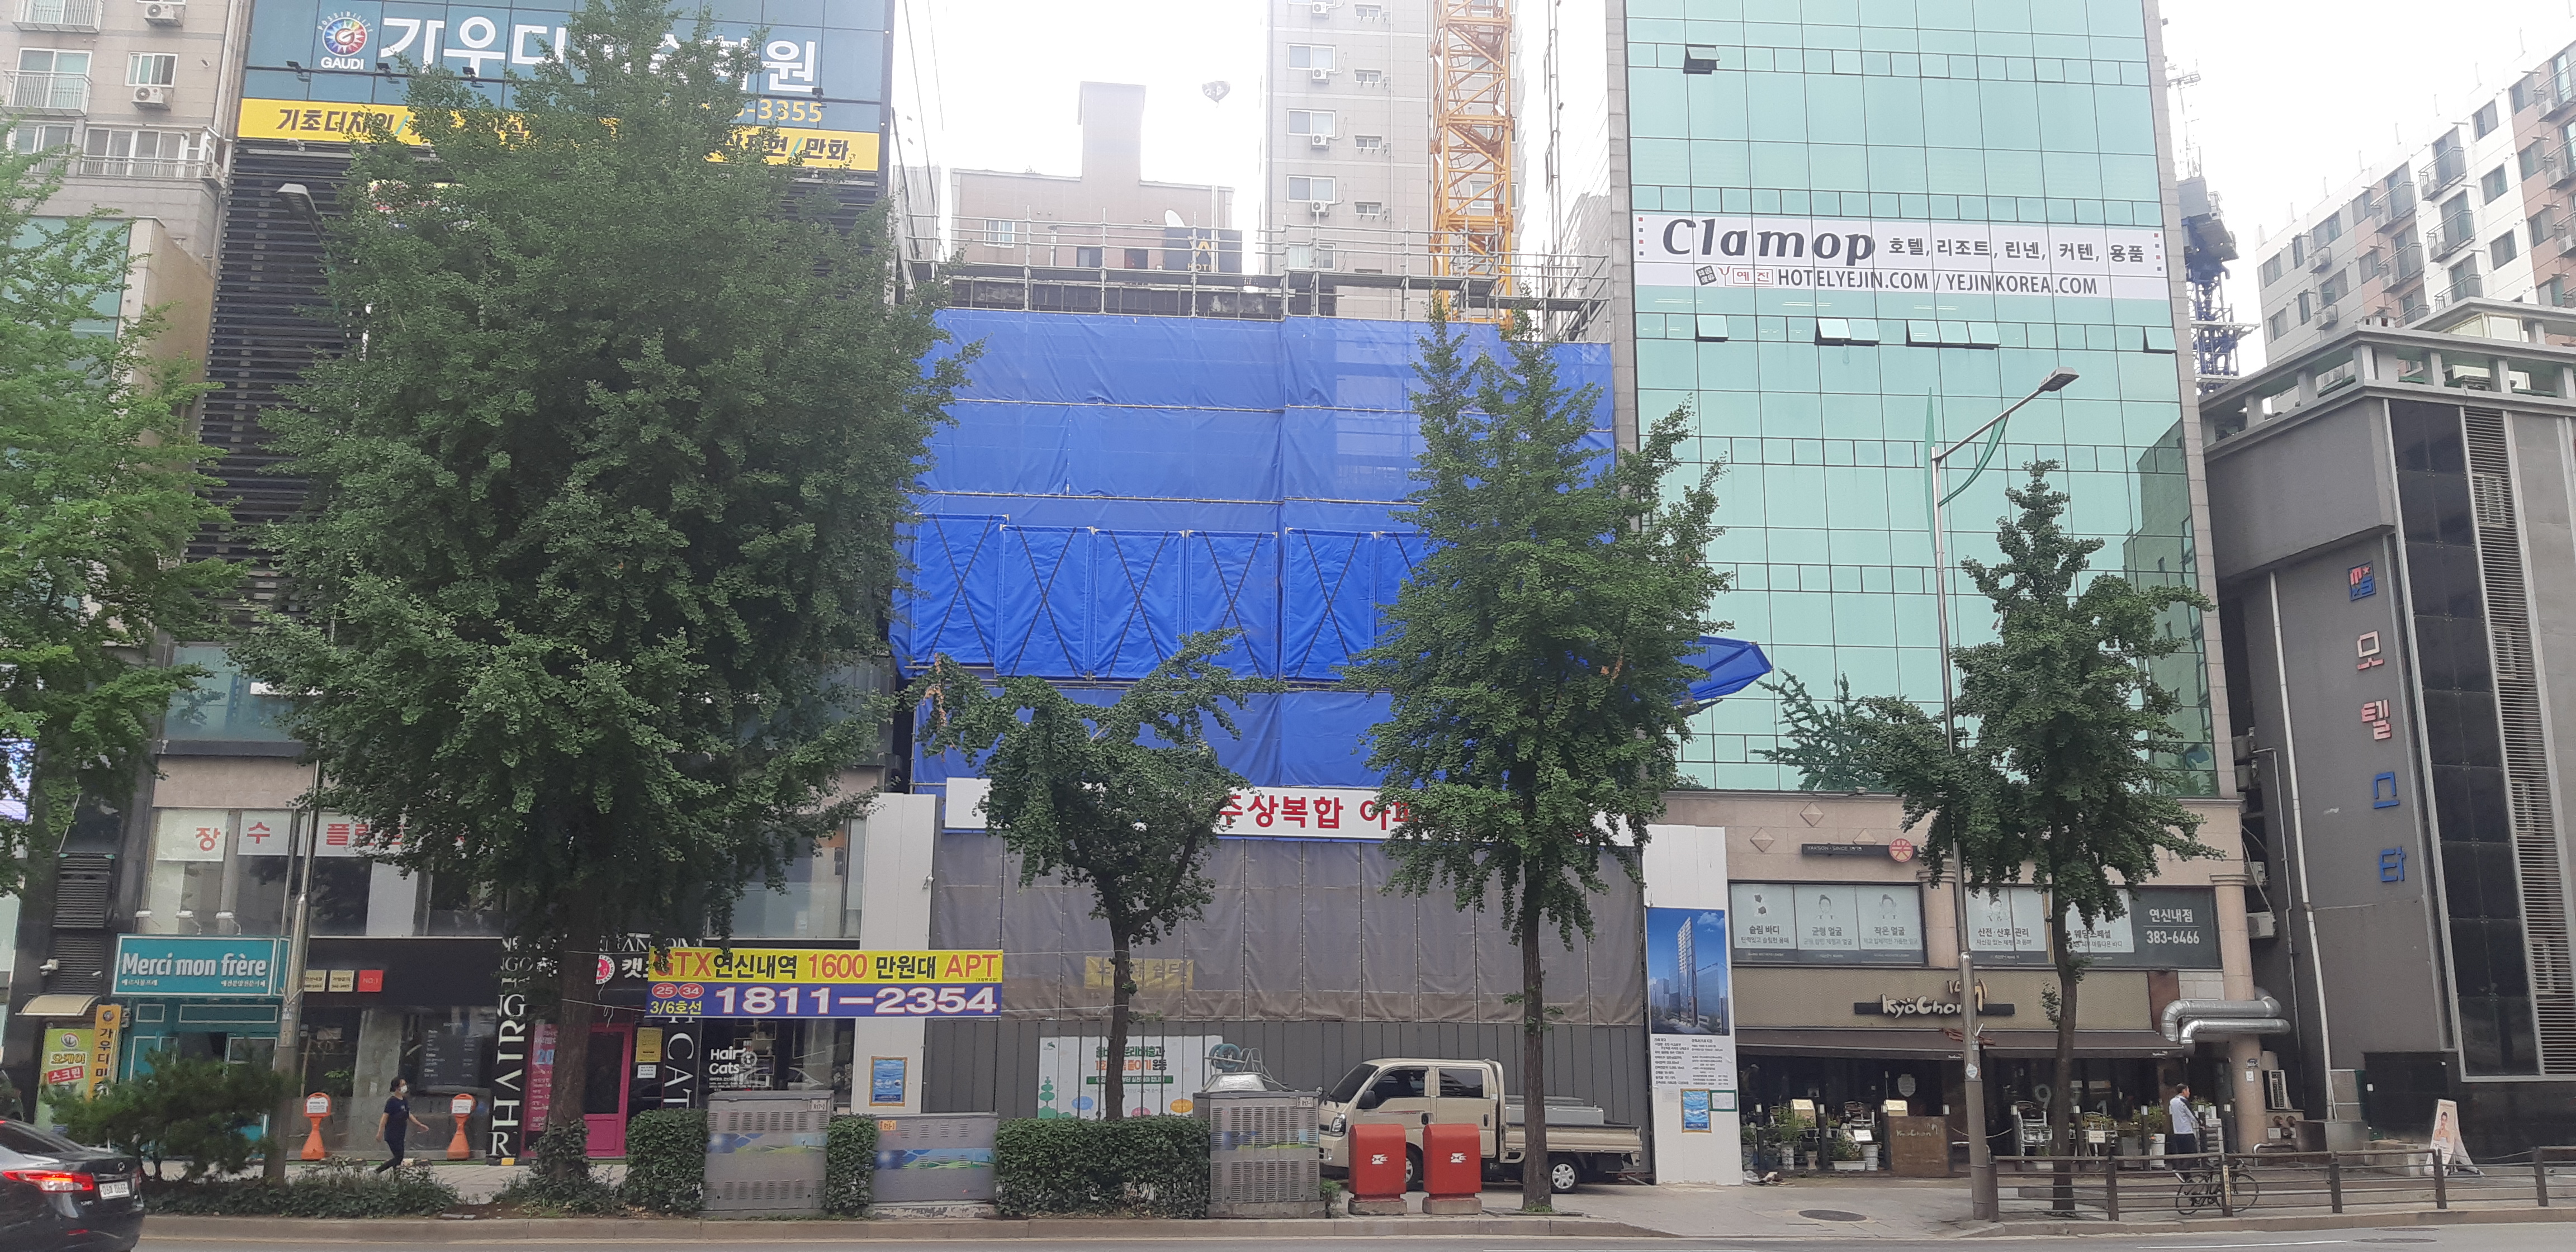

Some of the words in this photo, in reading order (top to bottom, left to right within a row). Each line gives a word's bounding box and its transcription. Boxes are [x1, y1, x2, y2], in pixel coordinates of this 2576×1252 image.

[321, 56, 364, 69] GAUDI
[805, 137, 849, 161] 만화
[1663, 218, 1876, 267] Clamop
[1888, 238, 1930, 257] 호텔,
[1936, 239, 1998, 259] 리조트,
[2005, 241, 2046, 261] 린넨,
[2059, 243, 2100, 263] 커텐,
[2109, 244, 2144, 263] 용품
[1736, 271, 1770, 282] 예진
[1778, 269, 1929, 290] HOTELYEJIN.COM
[1947, 273, 2098, 295] YEJINKOREA.COM
[1219, 796, 1344, 829] 주상복합
[2149, 908, 2194, 923] 연신내점
[1749, 925, 1764, 935] 슬림
[1765, 925, 1780, 935] 바디
[1874, 926, 1890, 936] 작은
[1890, 926, 1905, 936] 얼굴
[2014, 928, 2030, 938] 관리
[2146, 929, 2200, 945] 383-6466
[121, 952, 173, 976] Merci
[174, 959, 217, 976] mon
[220, 952, 267, 976] frère
[808, 953, 868, 979] 1600
[875, 955, 937, 980] 만원대
[944, 954, 998, 979] APT
[656, 985, 674, 995] 25
[683, 985, 700, 995] 34
[650, 1000, 702, 1015] 3/6호선
[715, 986, 998, 1015] 1811-2354
[51, 1052, 86, 1064] 오케이
[711, 1046, 746, 1060] Hair
[51, 1067, 81, 1082] 스크린
[709, 1062, 740, 1075] Cats
